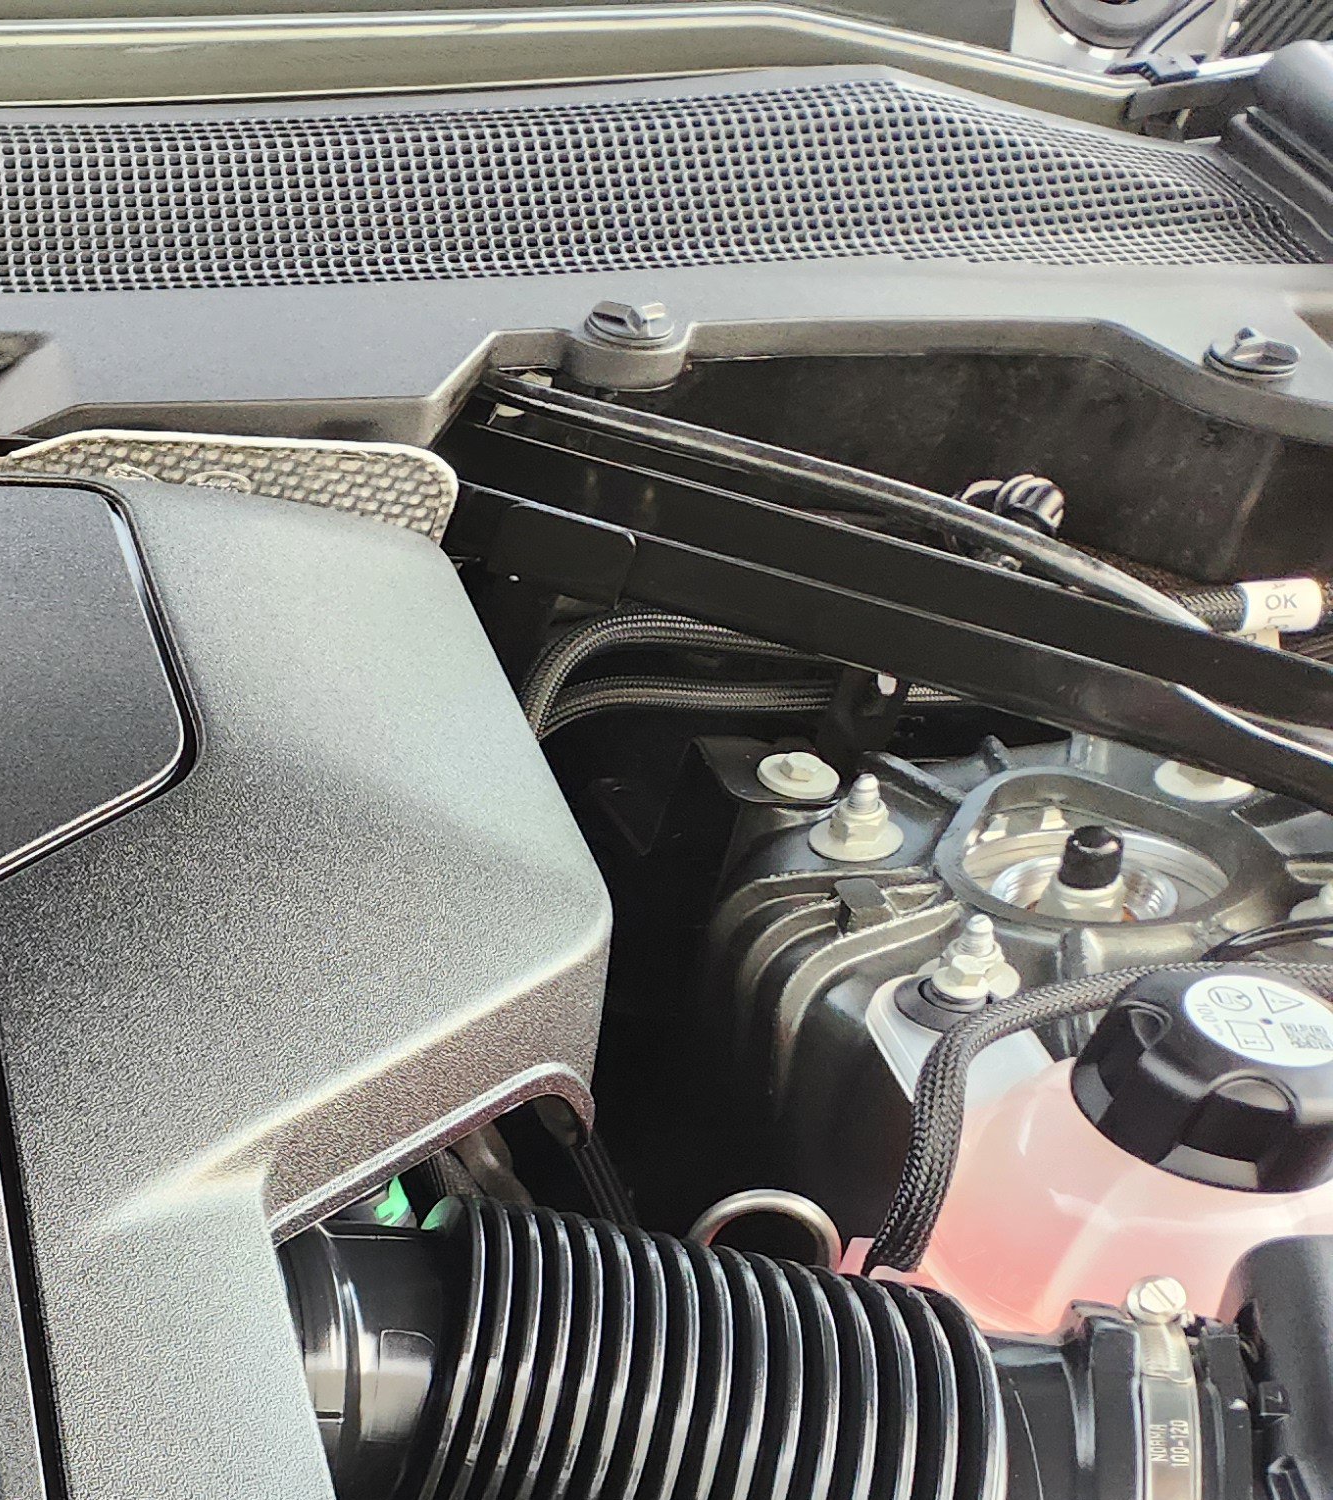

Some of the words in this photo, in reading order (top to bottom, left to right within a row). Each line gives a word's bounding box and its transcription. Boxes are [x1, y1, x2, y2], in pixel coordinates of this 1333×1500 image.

[1265, 593, 1297, 611] OK
[1148, 1423, 1169, 1462] NORMA
[1169, 1419, 1190, 1467] 100-120
